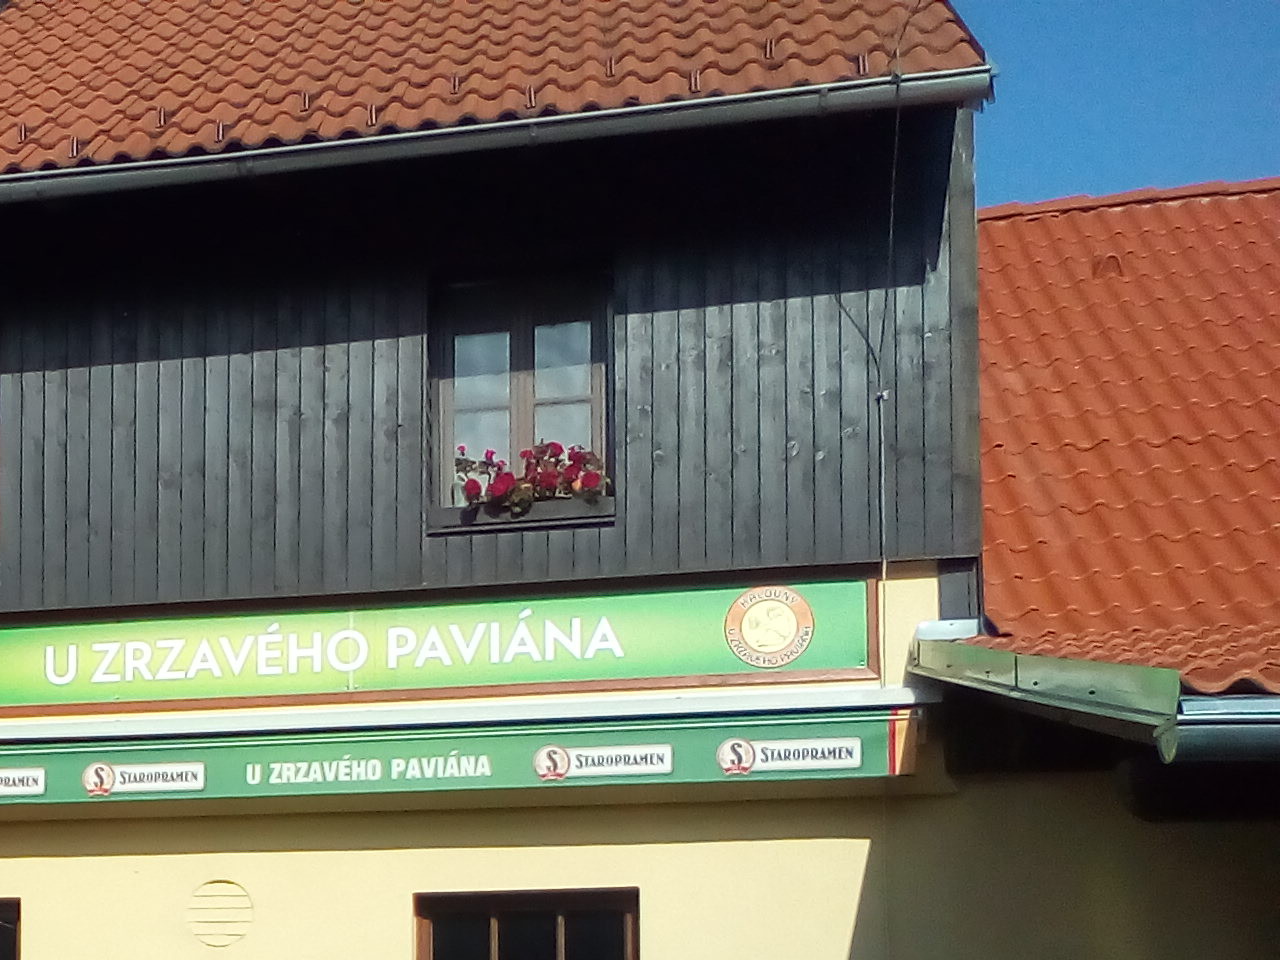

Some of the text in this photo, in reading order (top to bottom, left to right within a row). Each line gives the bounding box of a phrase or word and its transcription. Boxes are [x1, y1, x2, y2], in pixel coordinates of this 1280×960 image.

[44, 608, 625, 686] U ZRZAVÉHO PAVIÁNA
[575, 752, 665, 768] STAROPRAMEN
[760, 746, 854, 763] STAROPRAMEN
[246, 750, 492, 785] U ZRZAVÉHO PAVIÁNA
[119, 770, 199, 785] STAROPRAMEN
